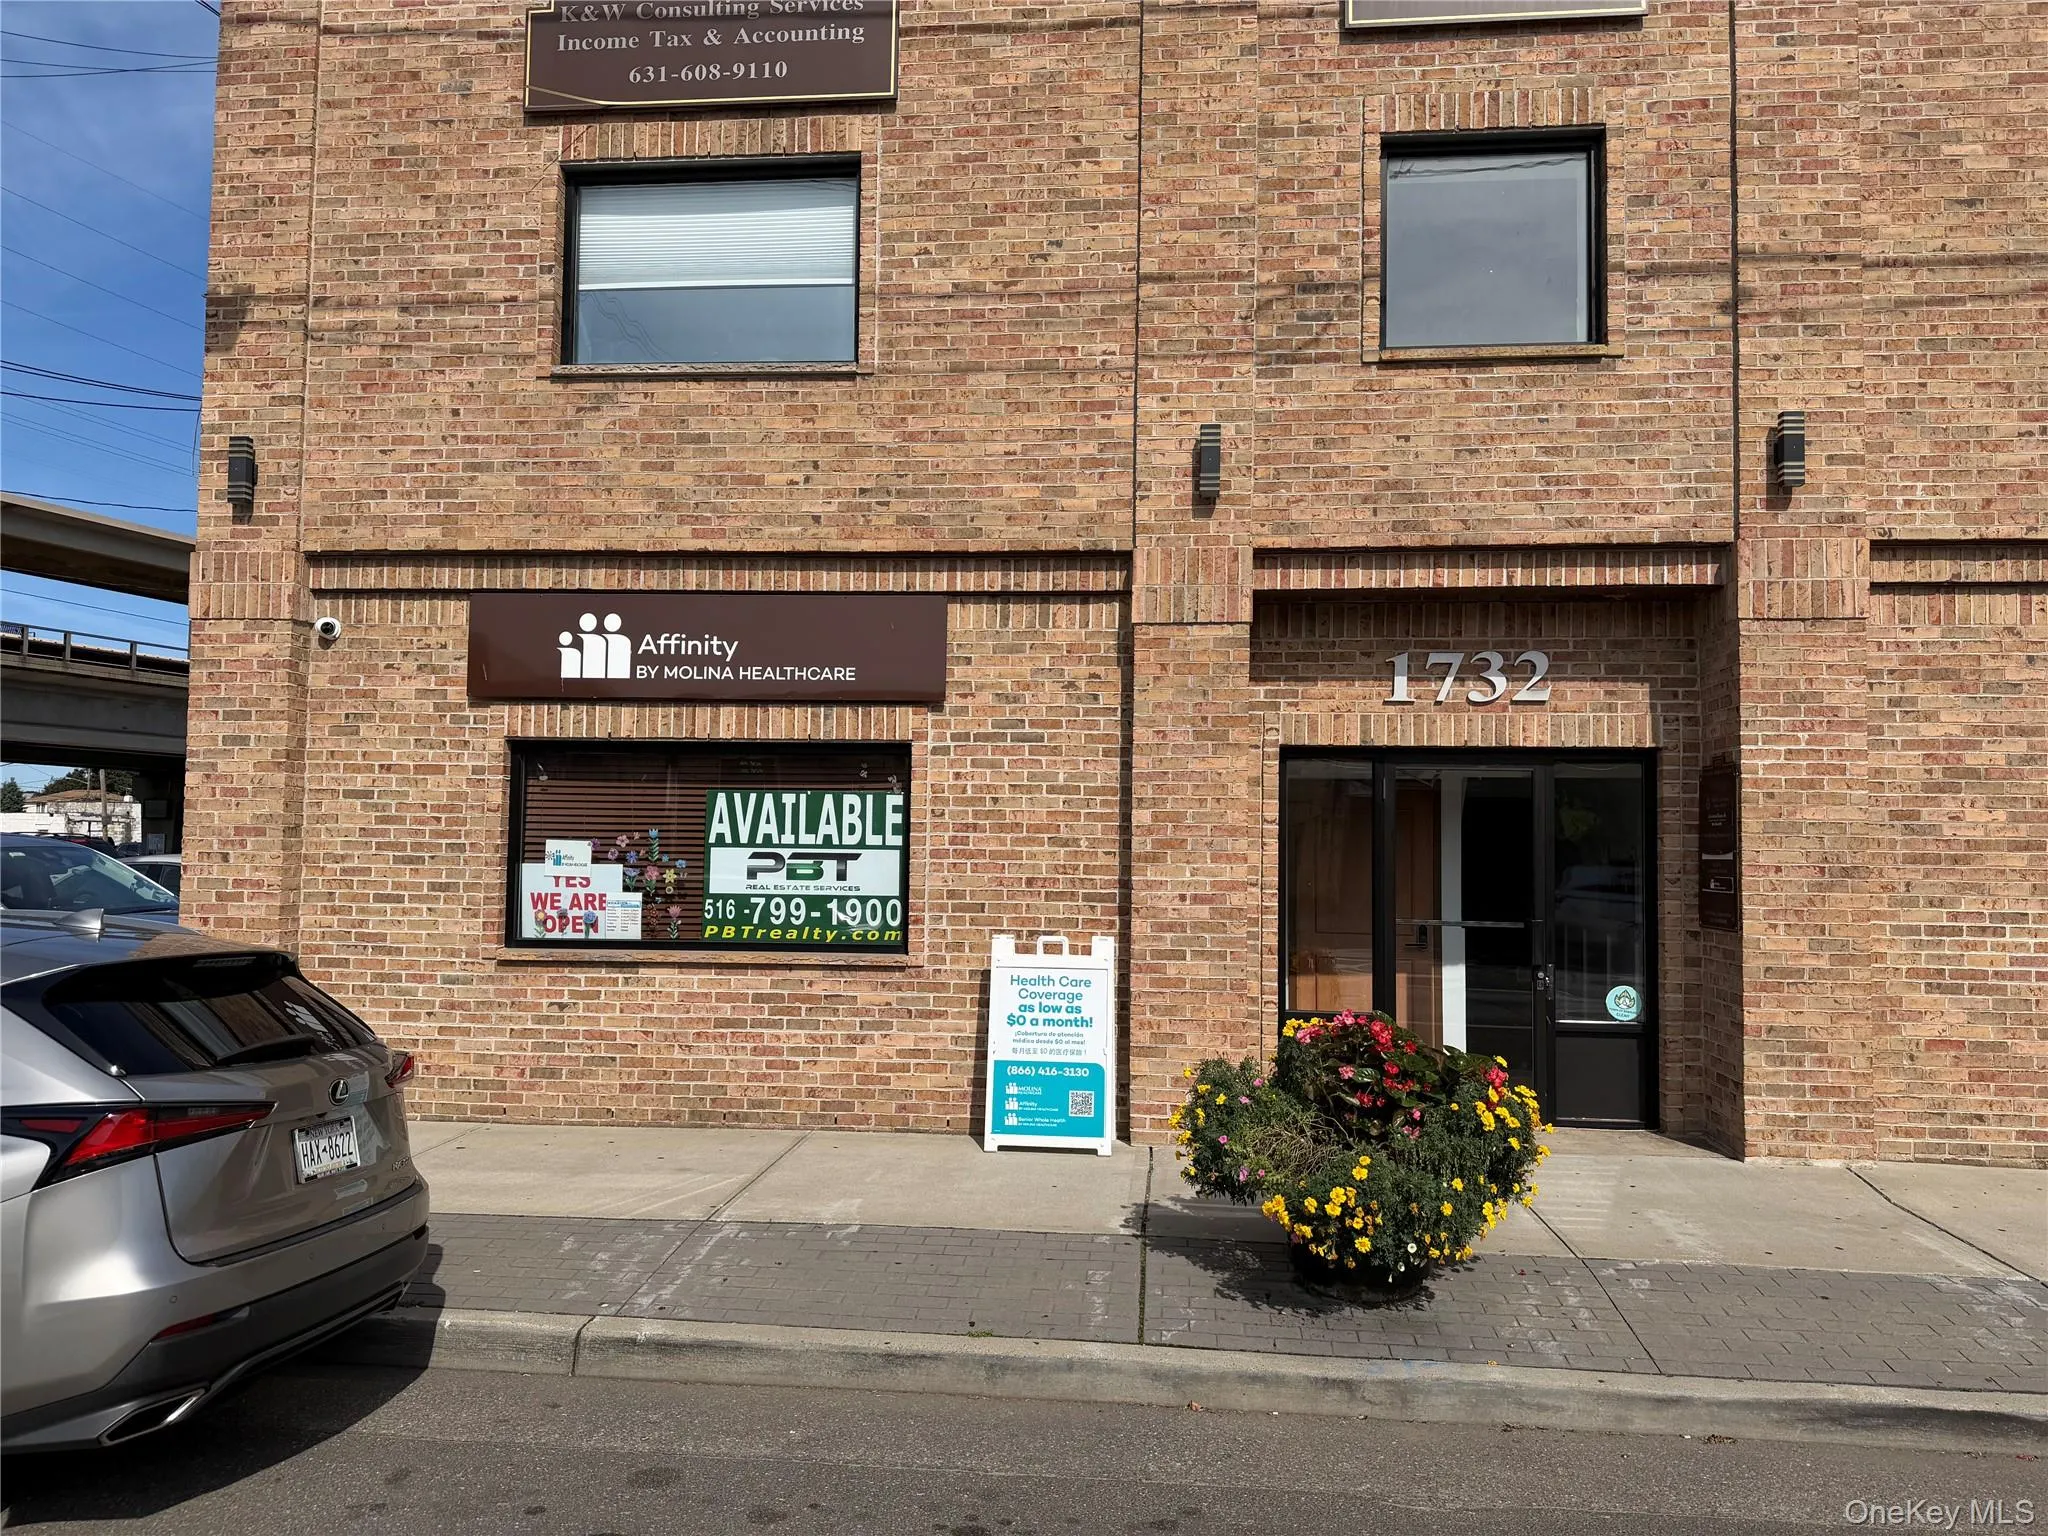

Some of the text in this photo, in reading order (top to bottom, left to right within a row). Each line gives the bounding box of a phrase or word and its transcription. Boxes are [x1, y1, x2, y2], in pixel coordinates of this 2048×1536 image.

[560, 0, 864, 23] K&W Consulting Services
[557, 23, 865, 51] Income Tax & Accounting
[629, 60, 788, 84] 631-608-9110
[637, 633, 739, 662] Affinity
[636, 665, 856, 681] BY MOLINA HEALTHCARE
[1383, 651, 1552, 704] 1732
[708, 792, 904, 846] AVAILABLE
[746, 851, 863, 881] PBT
[553, 876, 591, 888] YES
[530, 892, 607, 911] WE ARE
[704, 898, 736, 920] 516
[704, 925, 903, 942] PBTrealty.com
[1010, 974, 1092, 988] Health Care
[1018, 988, 1083, 1004] Coverage
[1018, 1001, 1082, 1014] as low as
[1006, 1012, 1093, 1028] $0 a month!
[1007, 1065, 1090, 1077] (866) 416-3130
